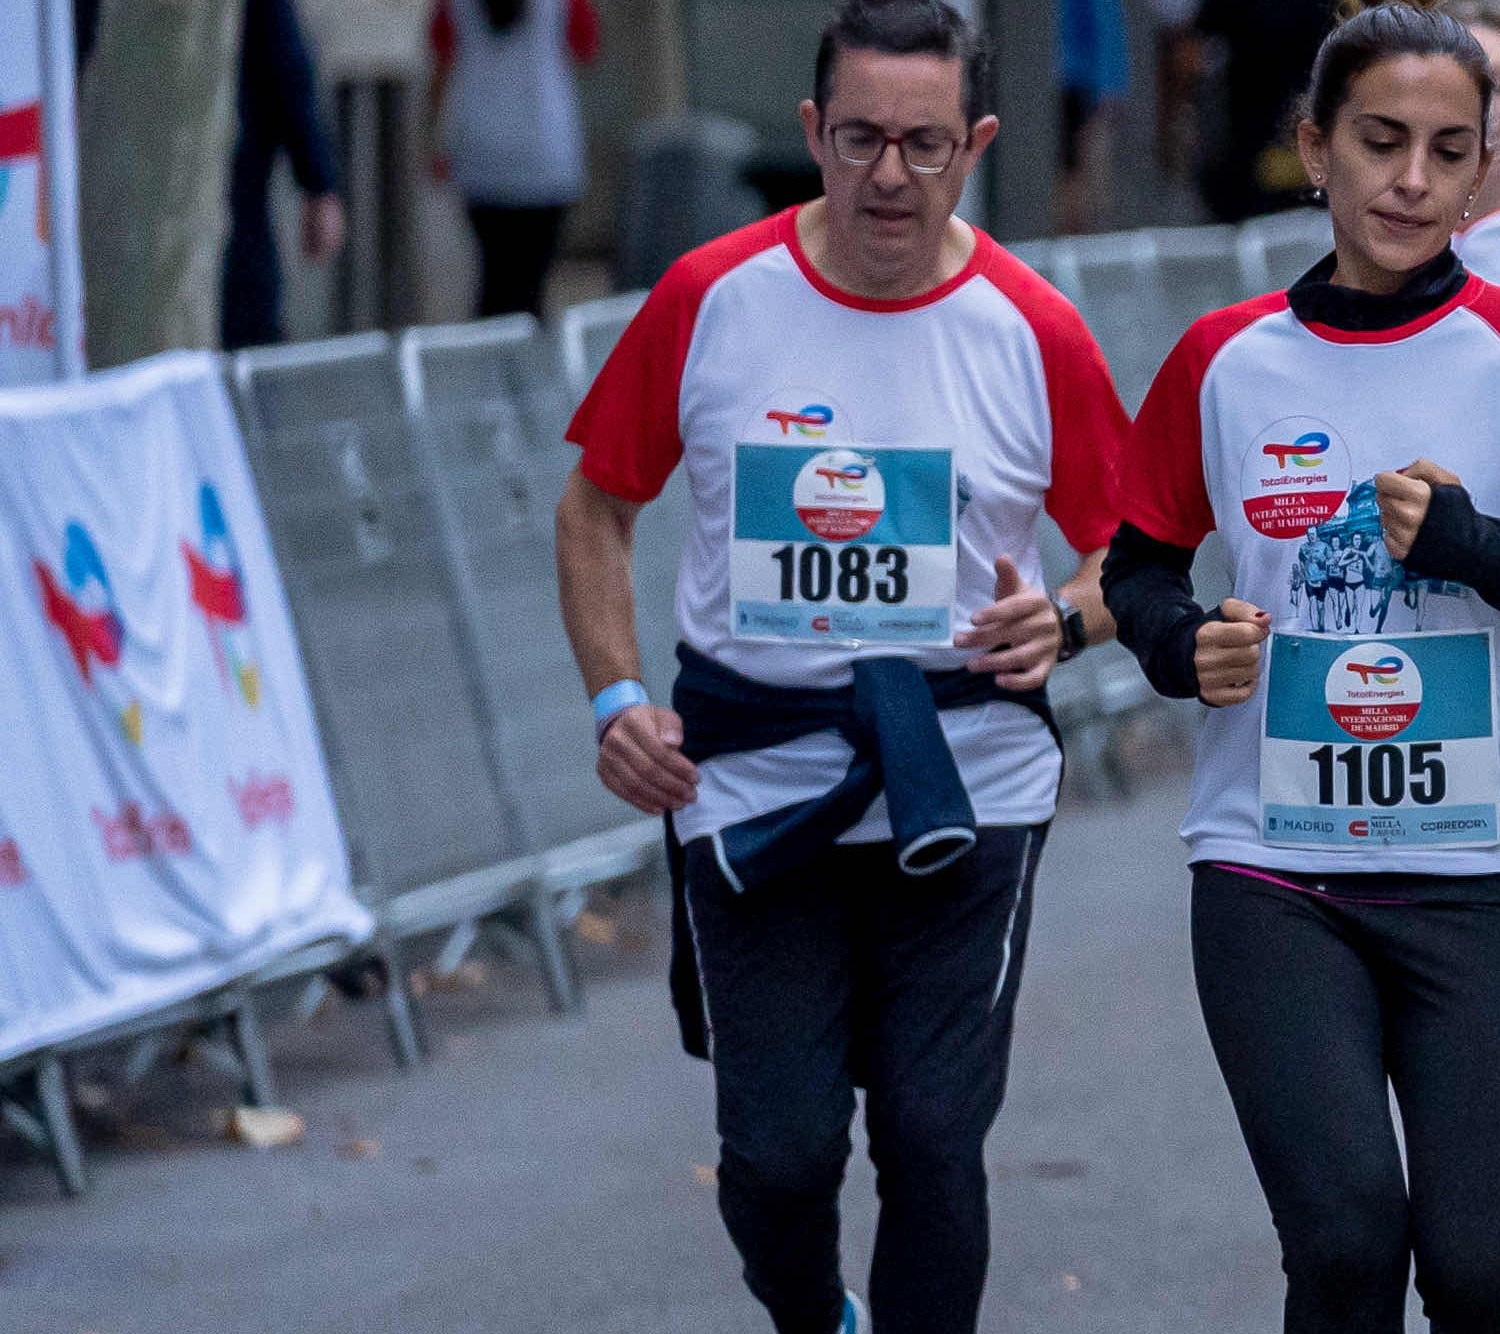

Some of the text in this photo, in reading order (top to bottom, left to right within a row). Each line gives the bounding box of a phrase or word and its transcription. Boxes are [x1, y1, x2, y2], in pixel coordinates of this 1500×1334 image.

[1261, 474, 1328, 487] TotalEnergies
[1273, 496, 1306, 507] MILLA
[772, 544, 908, 604] 1083
[1309, 742, 1447, 807] 1105
[1283, 820, 1335, 834] MADRID
